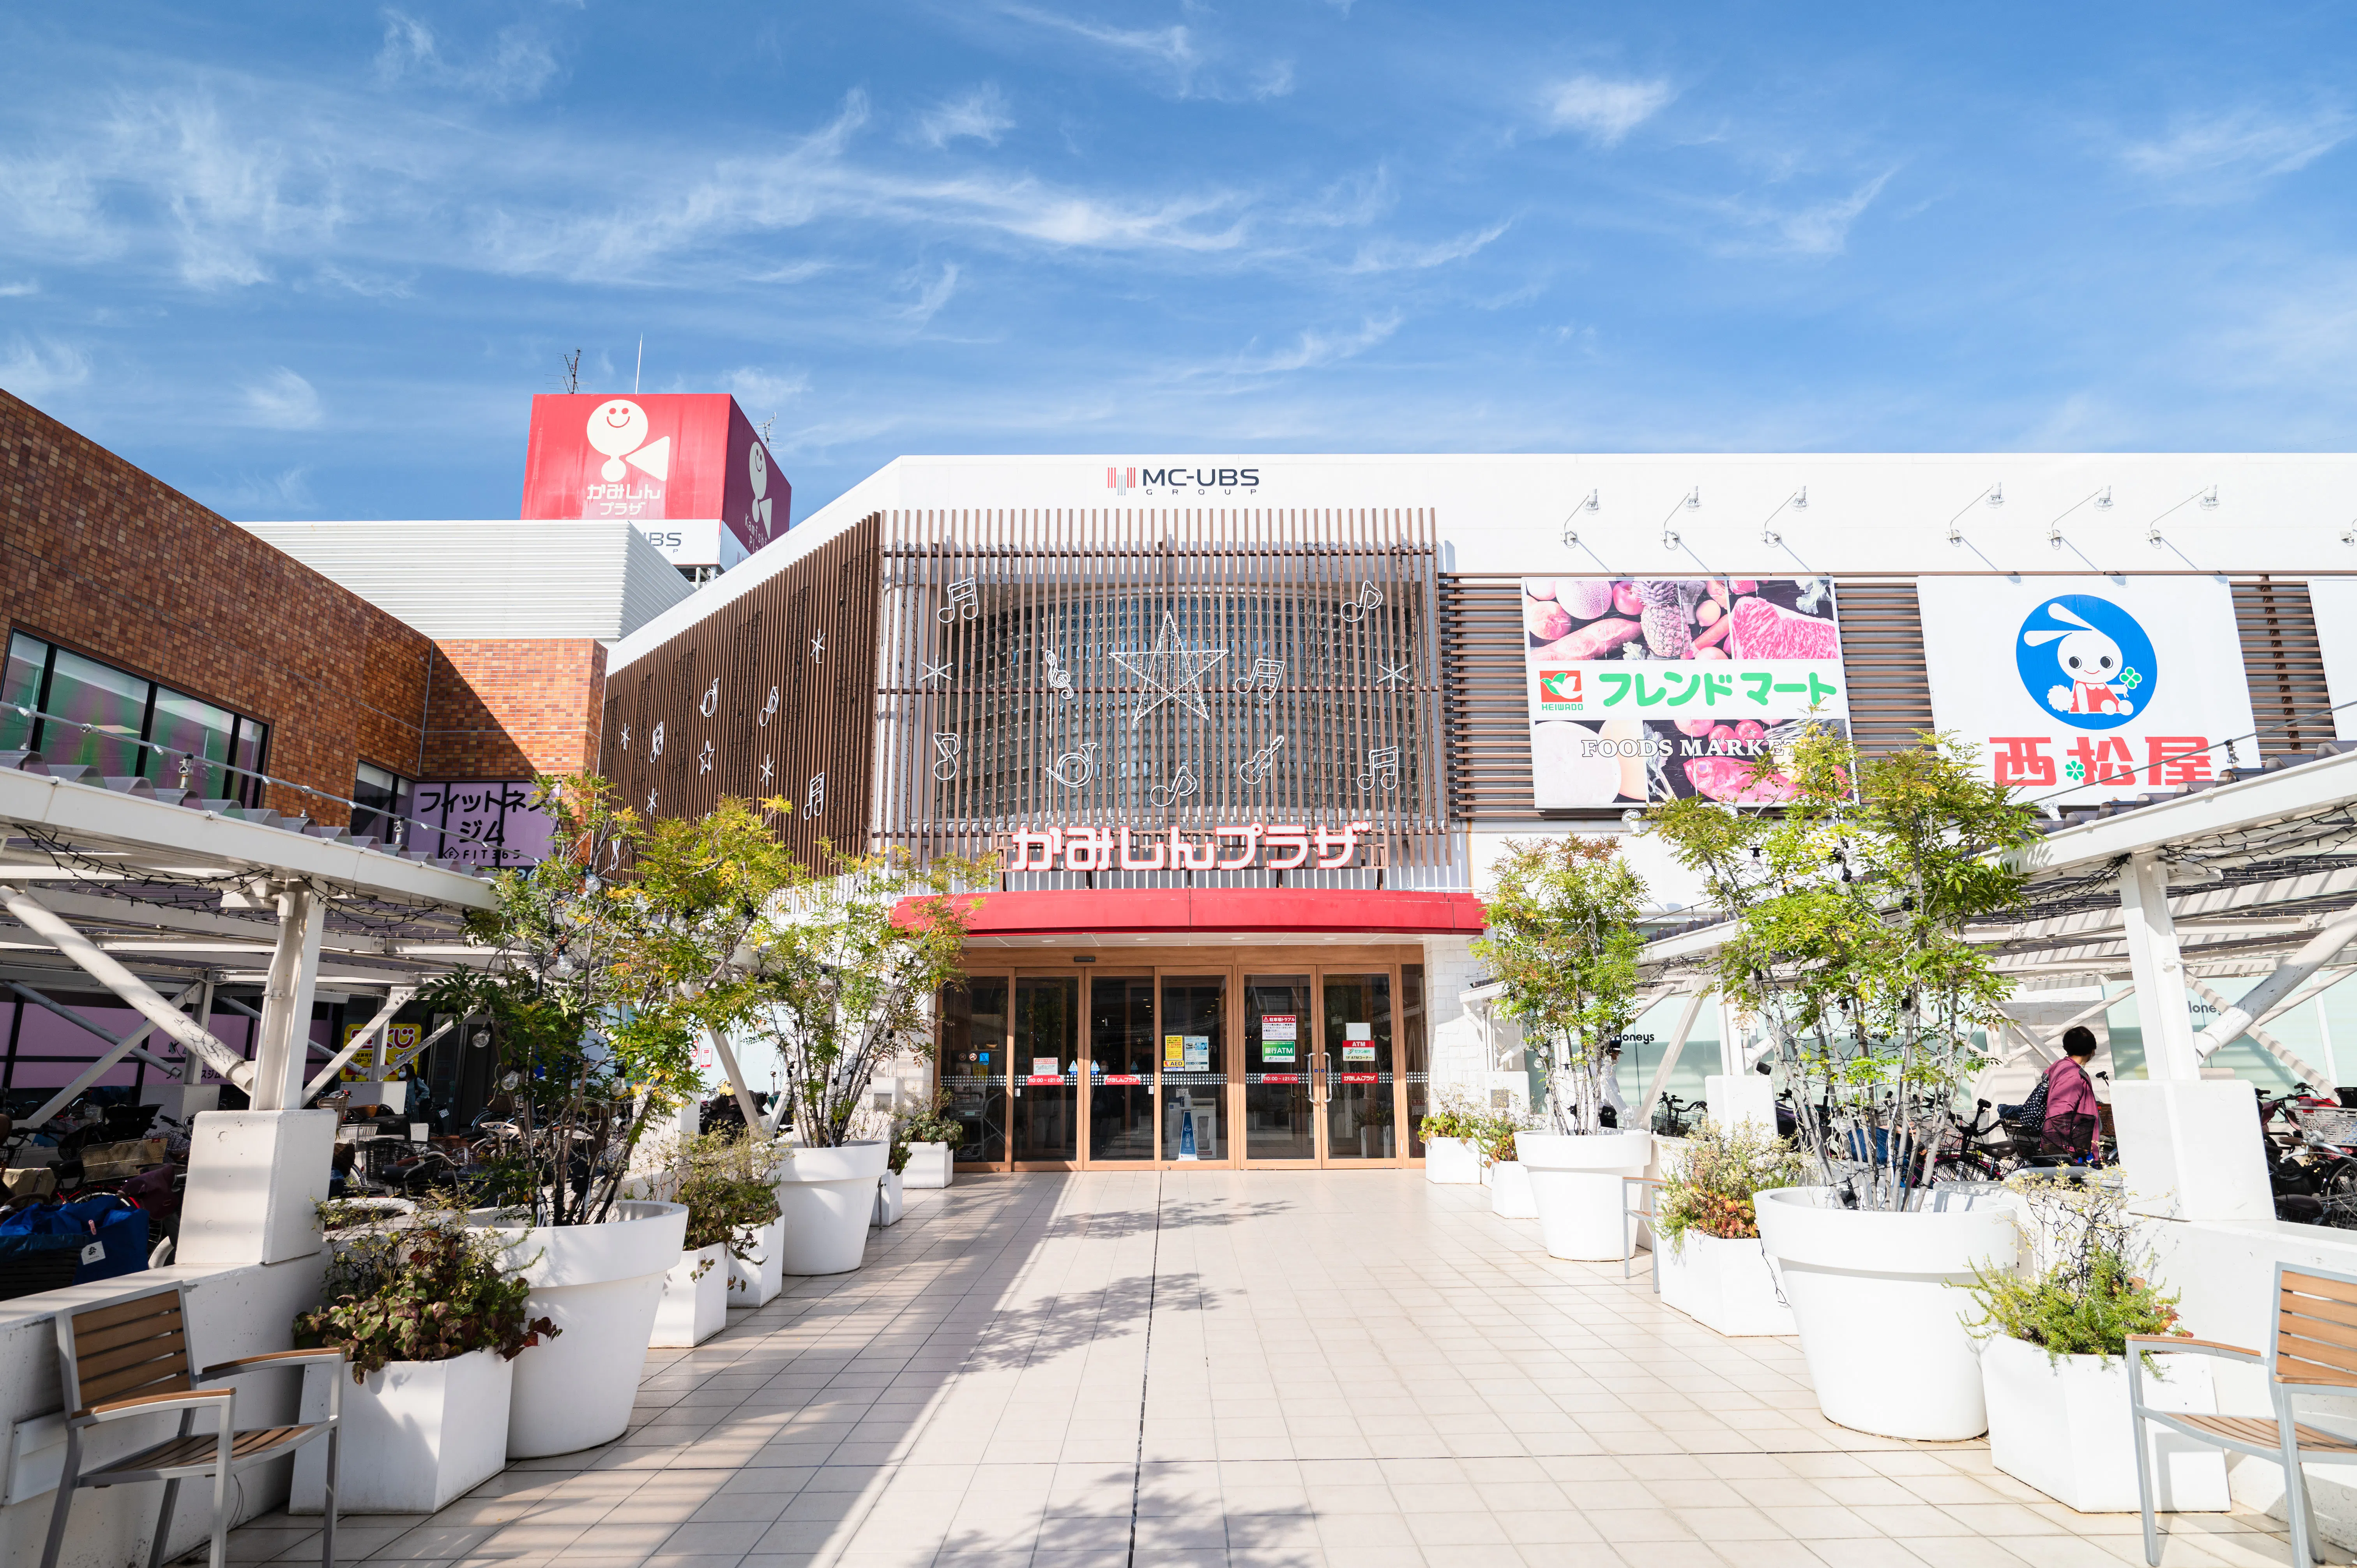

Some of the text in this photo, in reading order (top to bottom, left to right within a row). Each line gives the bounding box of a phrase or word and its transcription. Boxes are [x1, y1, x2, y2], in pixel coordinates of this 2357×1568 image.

[1143, 469, 1259, 486] MC-UBS
[587, 484, 661, 500] かみしん
[600, 501, 645, 516] プラザ
[1599, 671, 1837, 706] フレンドマート
[1582, 739, 1673, 758] FOODS
[1989, 736, 2214, 786] 西松屋
[459, 820, 505, 843] ジム
[1012, 821, 1371, 872] かみしんプラザ
